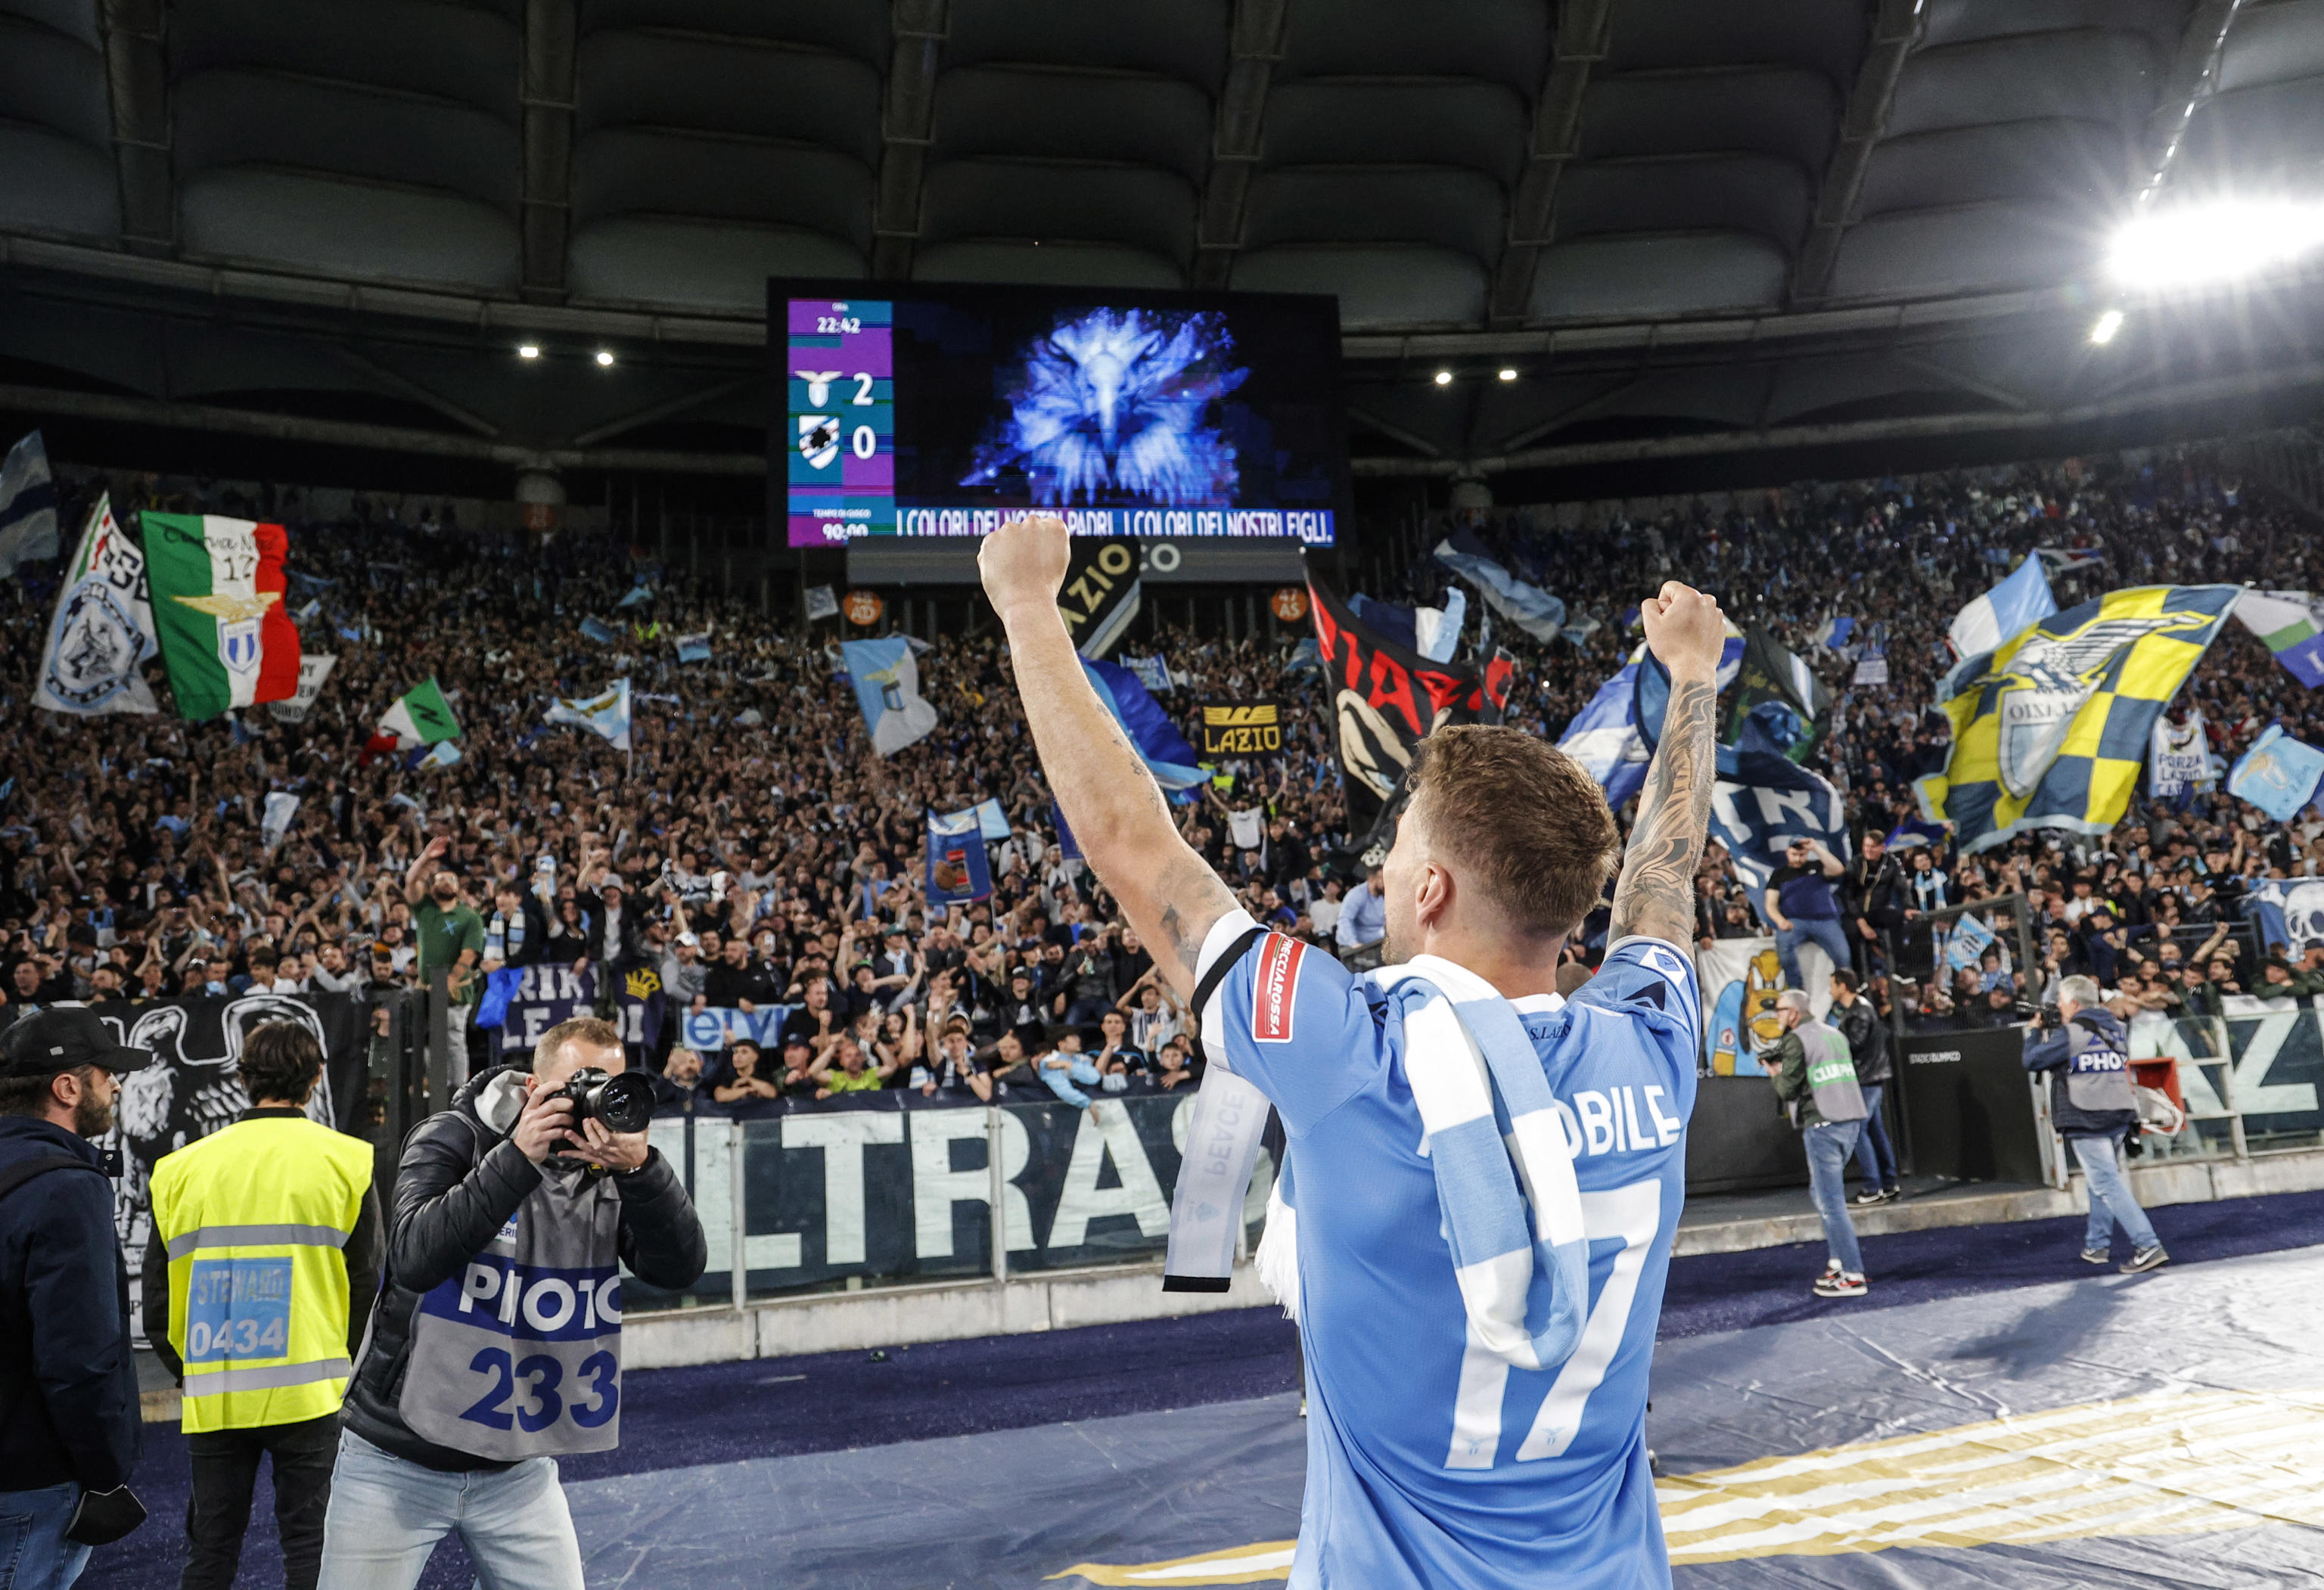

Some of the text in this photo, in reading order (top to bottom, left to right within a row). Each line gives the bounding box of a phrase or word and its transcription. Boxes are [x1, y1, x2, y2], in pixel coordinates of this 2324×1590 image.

[817, 316, 861, 334] 22:42
[853, 372, 874, 405] 2
[853, 425, 876, 459] 0
[822, 523, 868, 540] 90:00
[896, 510, 903, 536] I
[907, 510, 969, 536] COLORI
[973, 510, 1000, 536] DEI
[1067, 511, 1114, 536] PADRI
[1123, 511, 1130, 536] I
[1135, 511, 1193, 536] COLORI
[1197, 511, 1223, 536] DEI
[1226, 511, 1284, 536] NOSTRI
[1058, 543, 1131, 636] AZIO
[1279, 602, 1300, 617] AS
[1204, 724, 1282, 753] LAZIO
[1269, 937, 1294, 1036] FRECCIAROSSA
[197, 1269, 284, 1305] STEWARD
[190, 1317, 284, 1357] 0434
[1440, 1179, 1661, 1470] 17
[458, 1347, 619, 1433] 233
